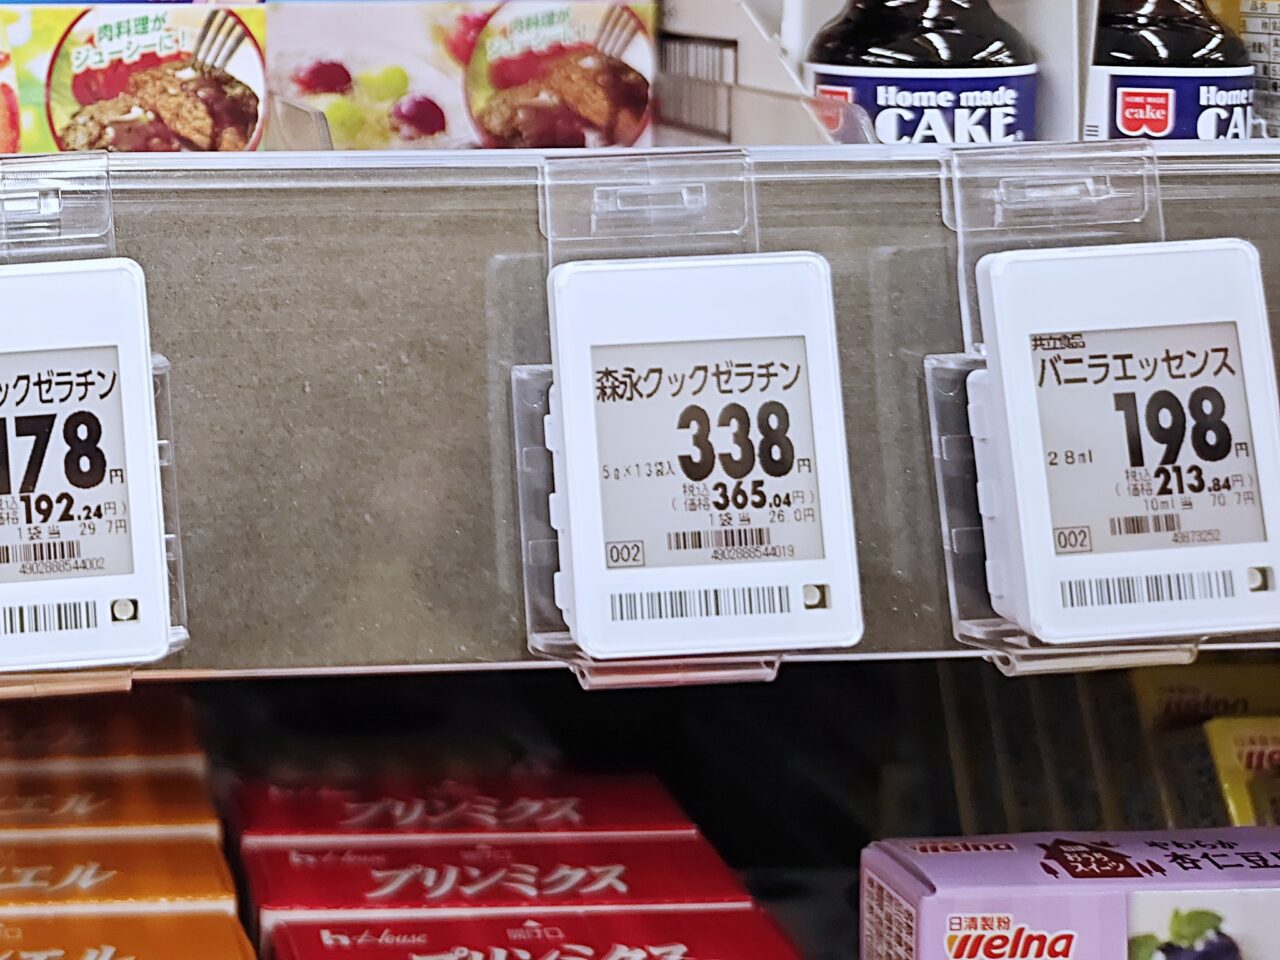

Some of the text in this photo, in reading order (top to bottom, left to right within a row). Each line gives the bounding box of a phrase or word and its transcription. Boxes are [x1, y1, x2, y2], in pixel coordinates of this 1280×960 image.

[97, 11, 167, 42] 肉料理が
[876, 86, 1018, 107] Home made
[1199, 85, 1247, 107] Home
[1124, 103, 1166, 120] cake
[875, 106, 1017, 144] CAKE
[1037, 347, 1236, 387] バニラエッセンス
[595, 361, 801, 402] 森永クックゼラチン
[1057, 529, 1088, 549] 002
[609, 544, 641, 564] 002
[1063, 852, 1109, 863] おうち
[1070, 862, 1126, 874] スイーツ
[365, 863, 629, 900] プリンミクス
[949, 916, 1011, 931] 日清製粉
